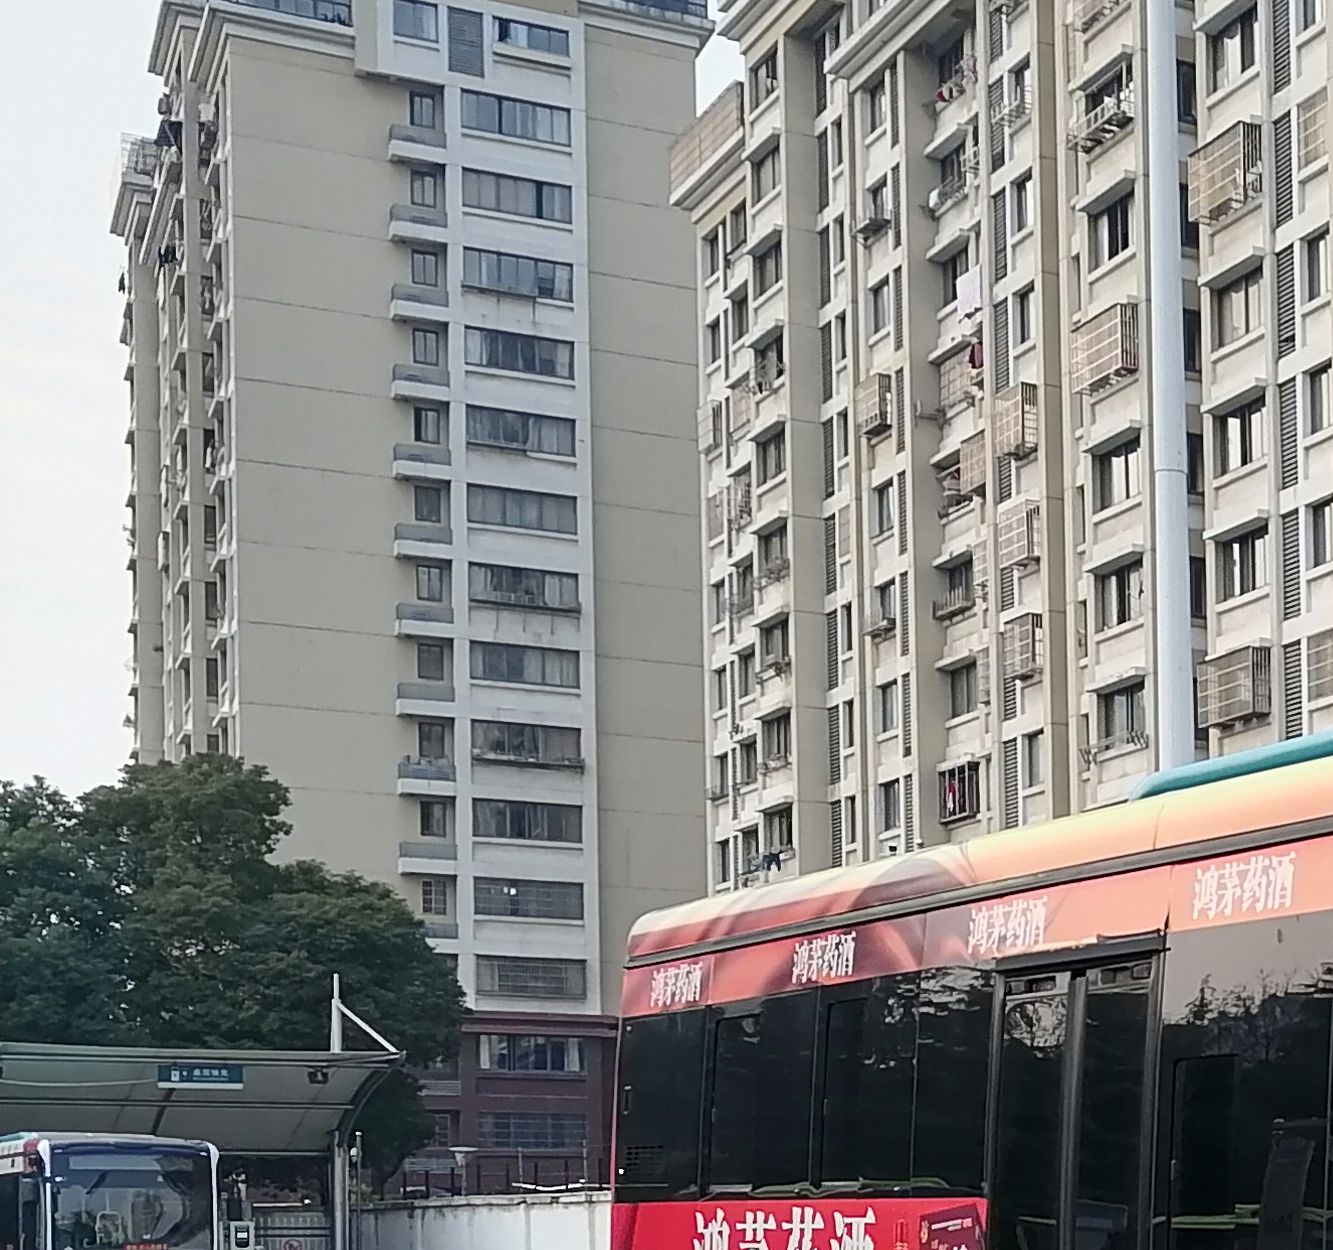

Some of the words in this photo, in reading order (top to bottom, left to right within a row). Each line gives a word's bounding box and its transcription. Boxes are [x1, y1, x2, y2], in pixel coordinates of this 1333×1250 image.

[1192, 851, 1296, 920] 鸿茅药酒
[967, 895, 1048, 955] 鸿茅药酒
[650, 961, 704, 1008] 鸿茅药酒
[791, 931, 857, 984] 鸿茅药酒
